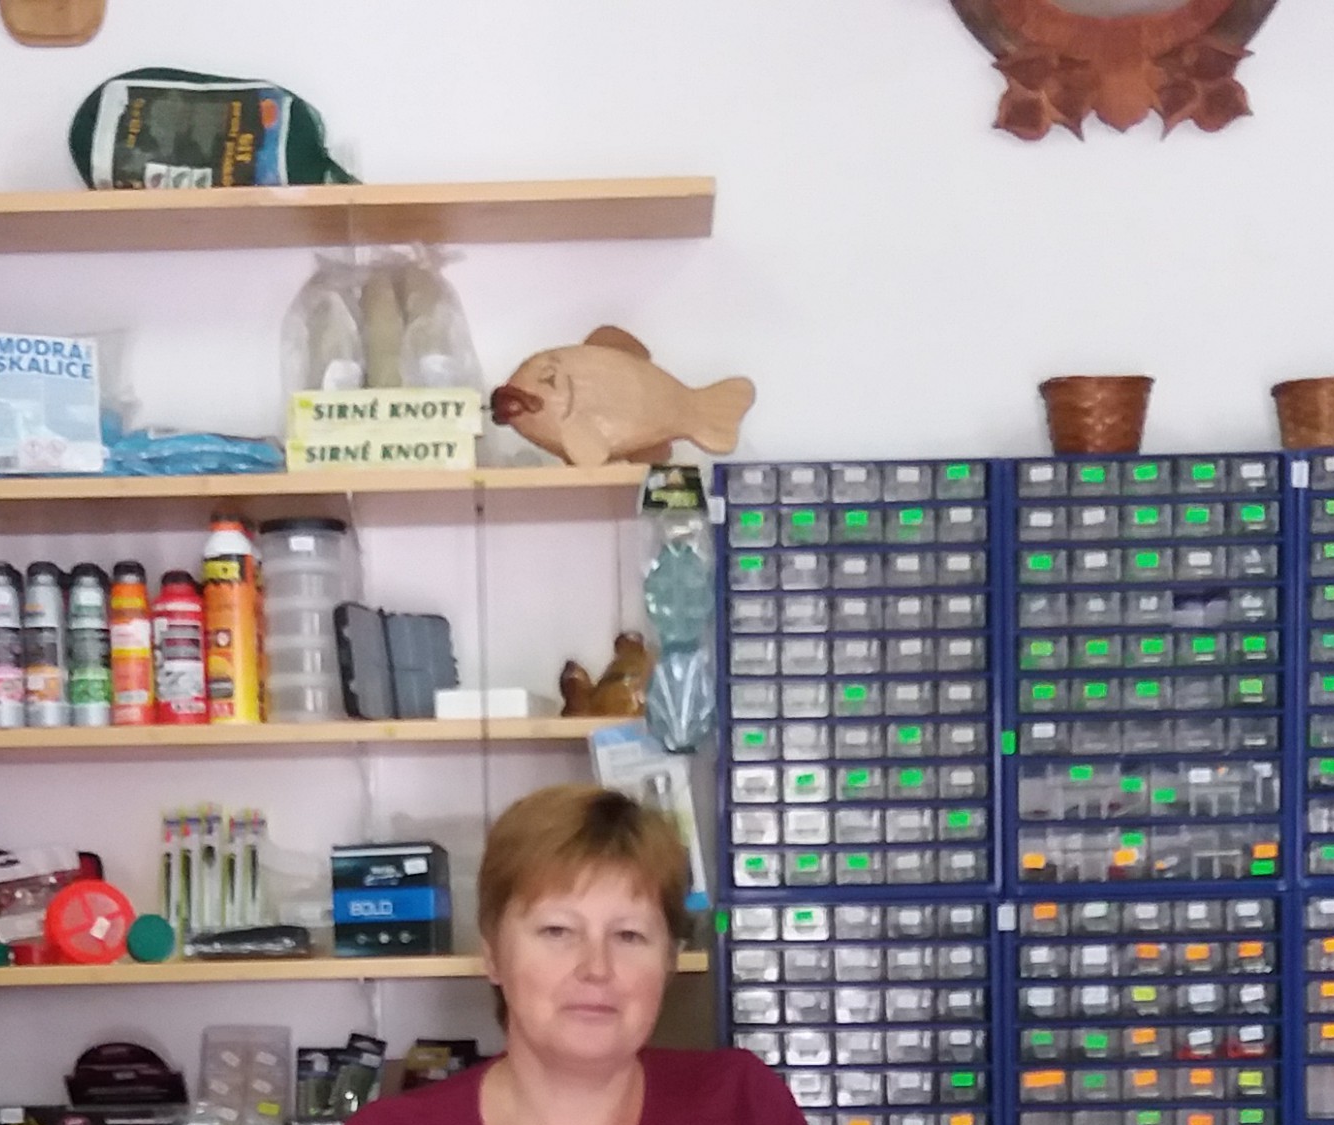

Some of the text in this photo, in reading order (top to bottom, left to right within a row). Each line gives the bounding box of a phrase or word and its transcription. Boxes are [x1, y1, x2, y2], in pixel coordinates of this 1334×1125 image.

[313, 397, 466, 421] SIRNÉ KNOTY
[305, 440, 458, 463] SIRNÉ KNOTY
